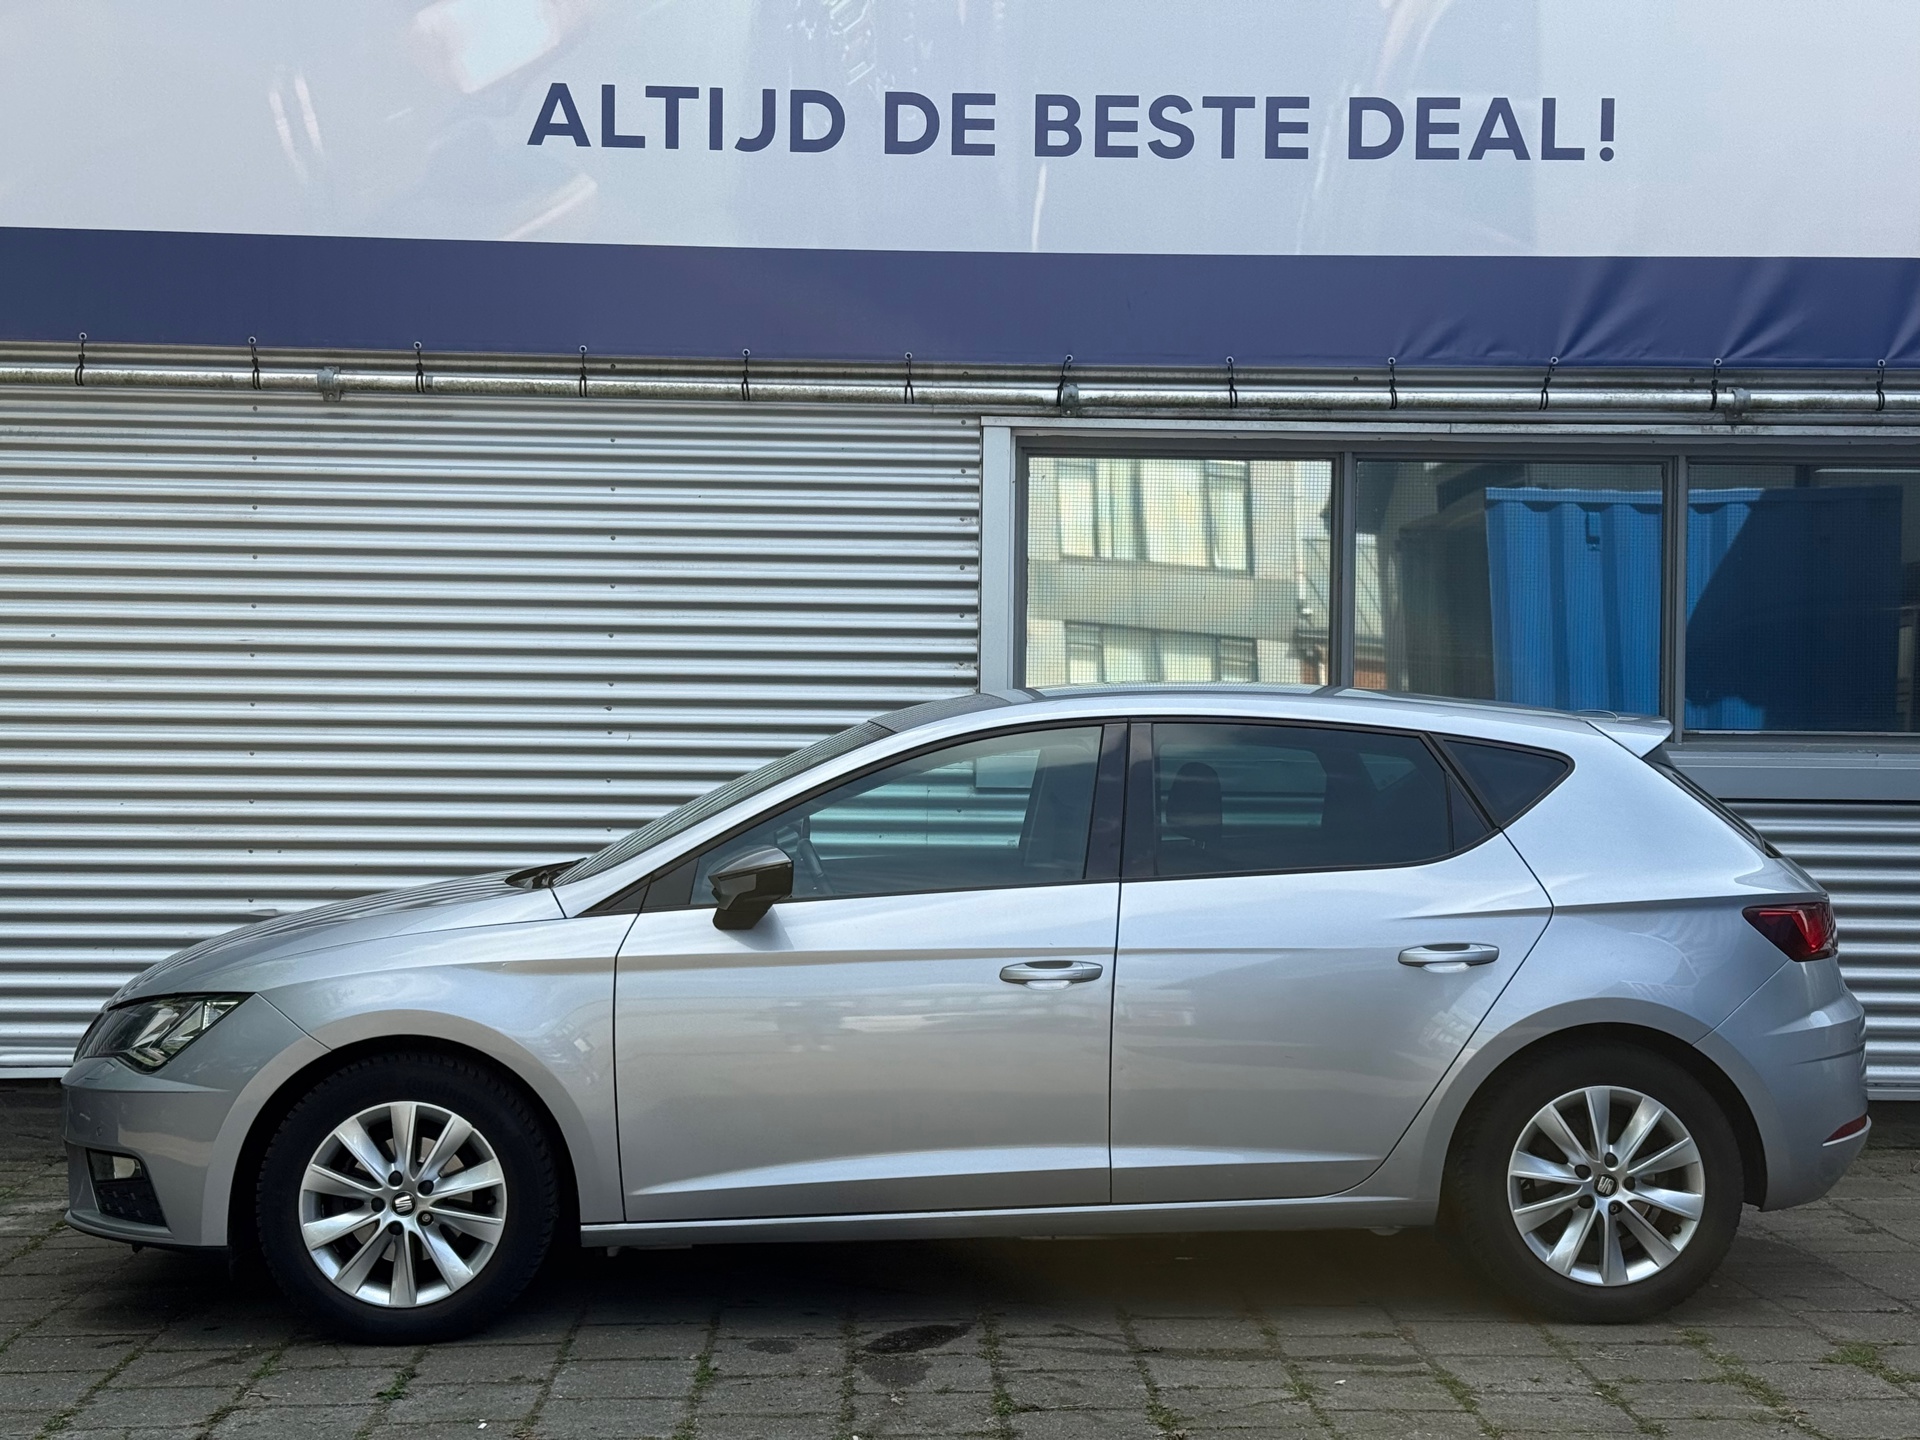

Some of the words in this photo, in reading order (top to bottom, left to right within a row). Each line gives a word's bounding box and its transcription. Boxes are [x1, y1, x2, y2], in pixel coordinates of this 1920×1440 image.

[527, 83, 845, 154] ALTIJD
[885, 92, 995, 156] DE
[1035, 94, 1309, 159] BESTE
[1348, 97, 1615, 161] DEAL!
